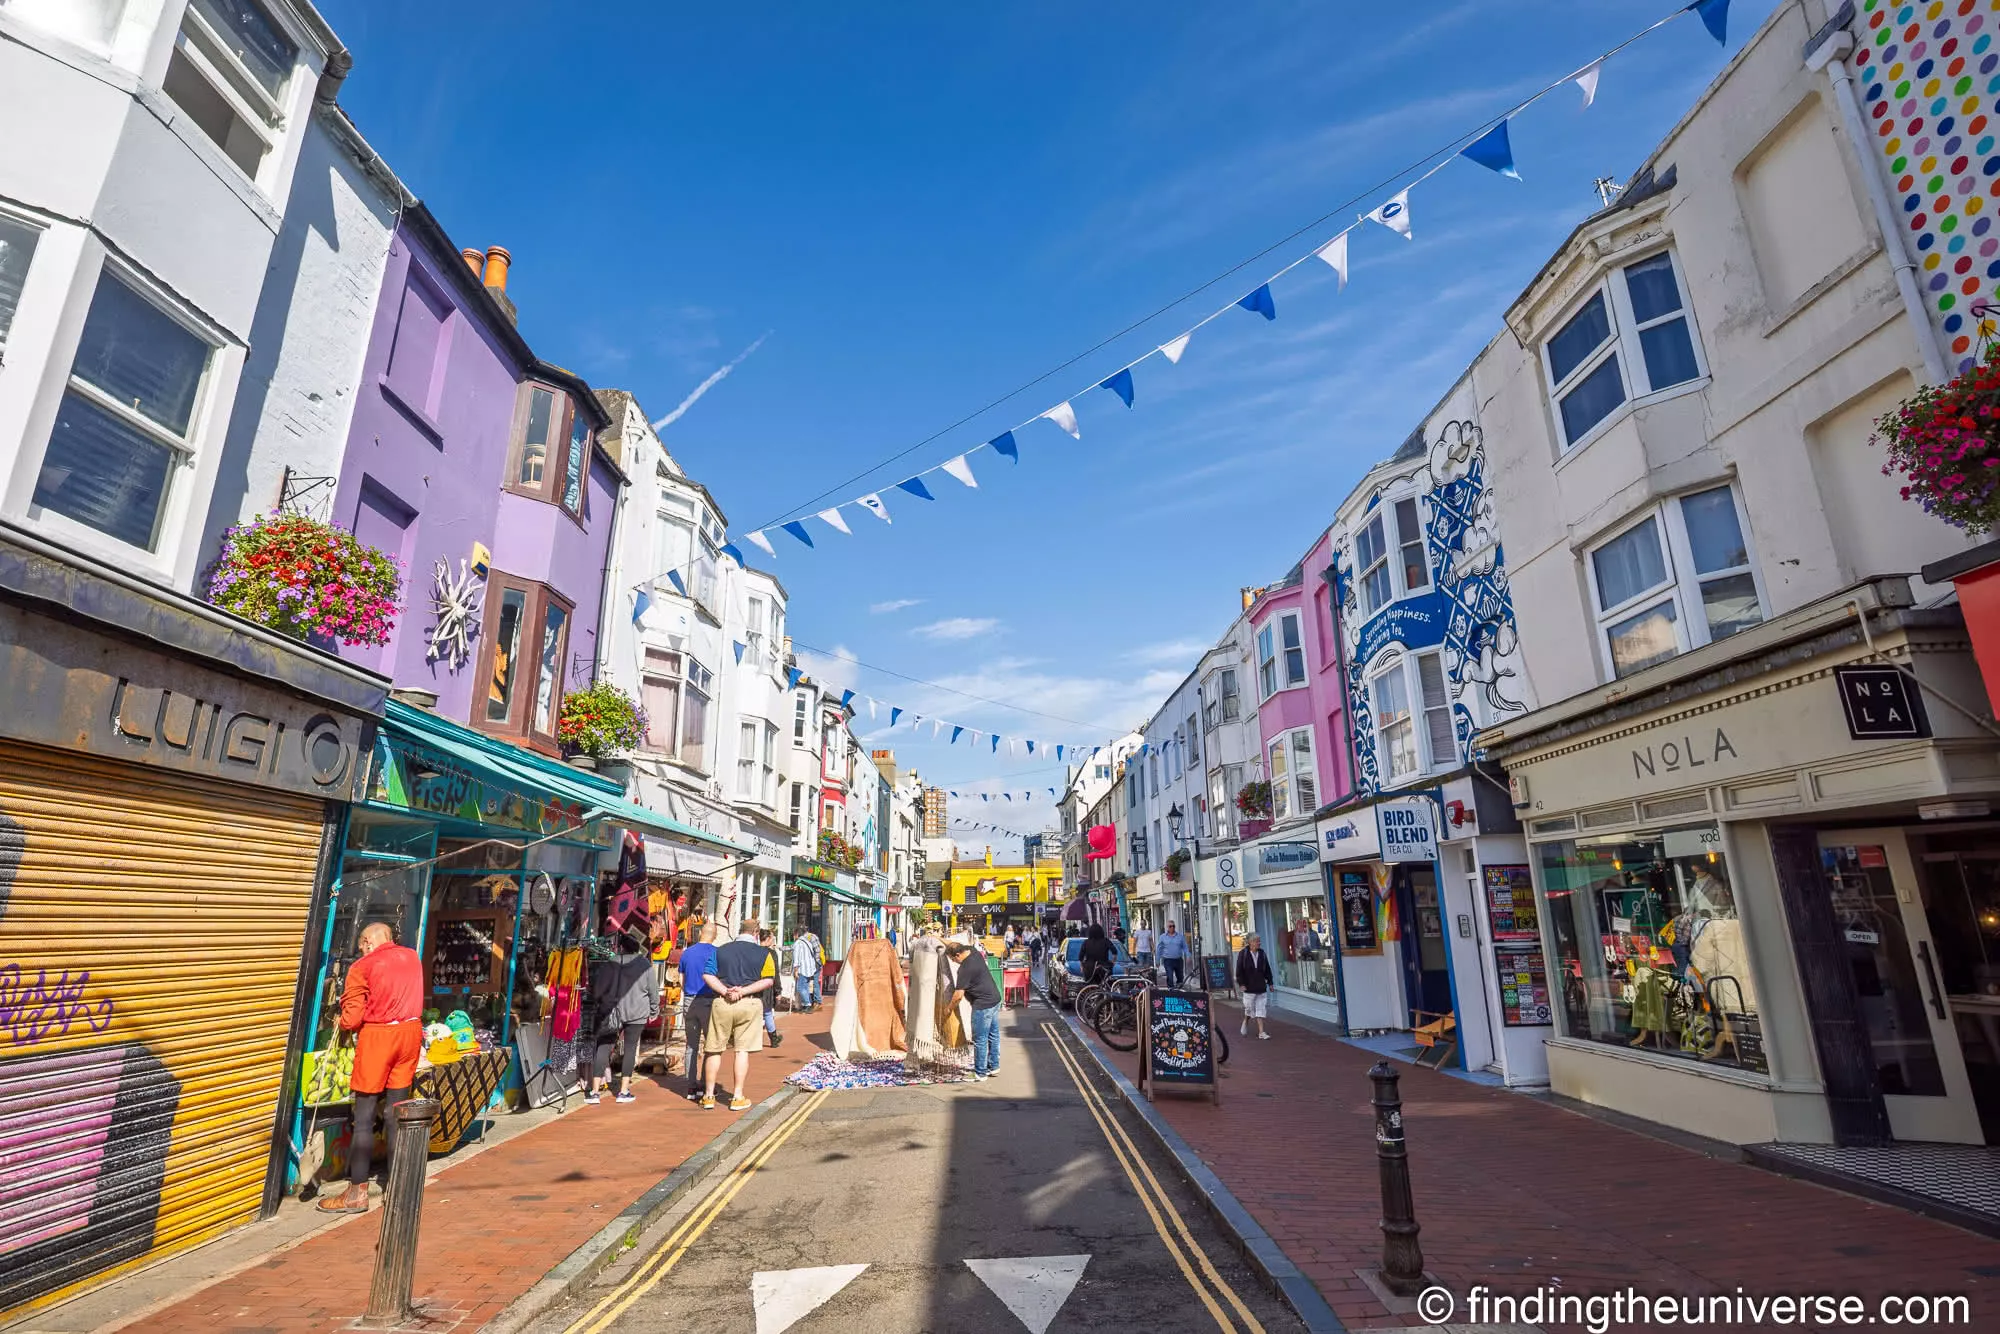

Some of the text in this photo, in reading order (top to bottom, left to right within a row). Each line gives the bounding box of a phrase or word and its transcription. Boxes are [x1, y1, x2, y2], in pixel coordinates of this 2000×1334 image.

[1365, 606, 1431, 643] Spreading Happiness.
[1391, 623, 1405, 637] Tea.
[1863, 706, 1902, 723] LA
[109, 677, 285, 774] LUIGI
[1535, 800, 1544, 811] 42
[1383, 810, 1427, 826] BIRD &
[1386, 826, 1429, 844] BLEND
[1388, 845, 1402, 855] TEA
